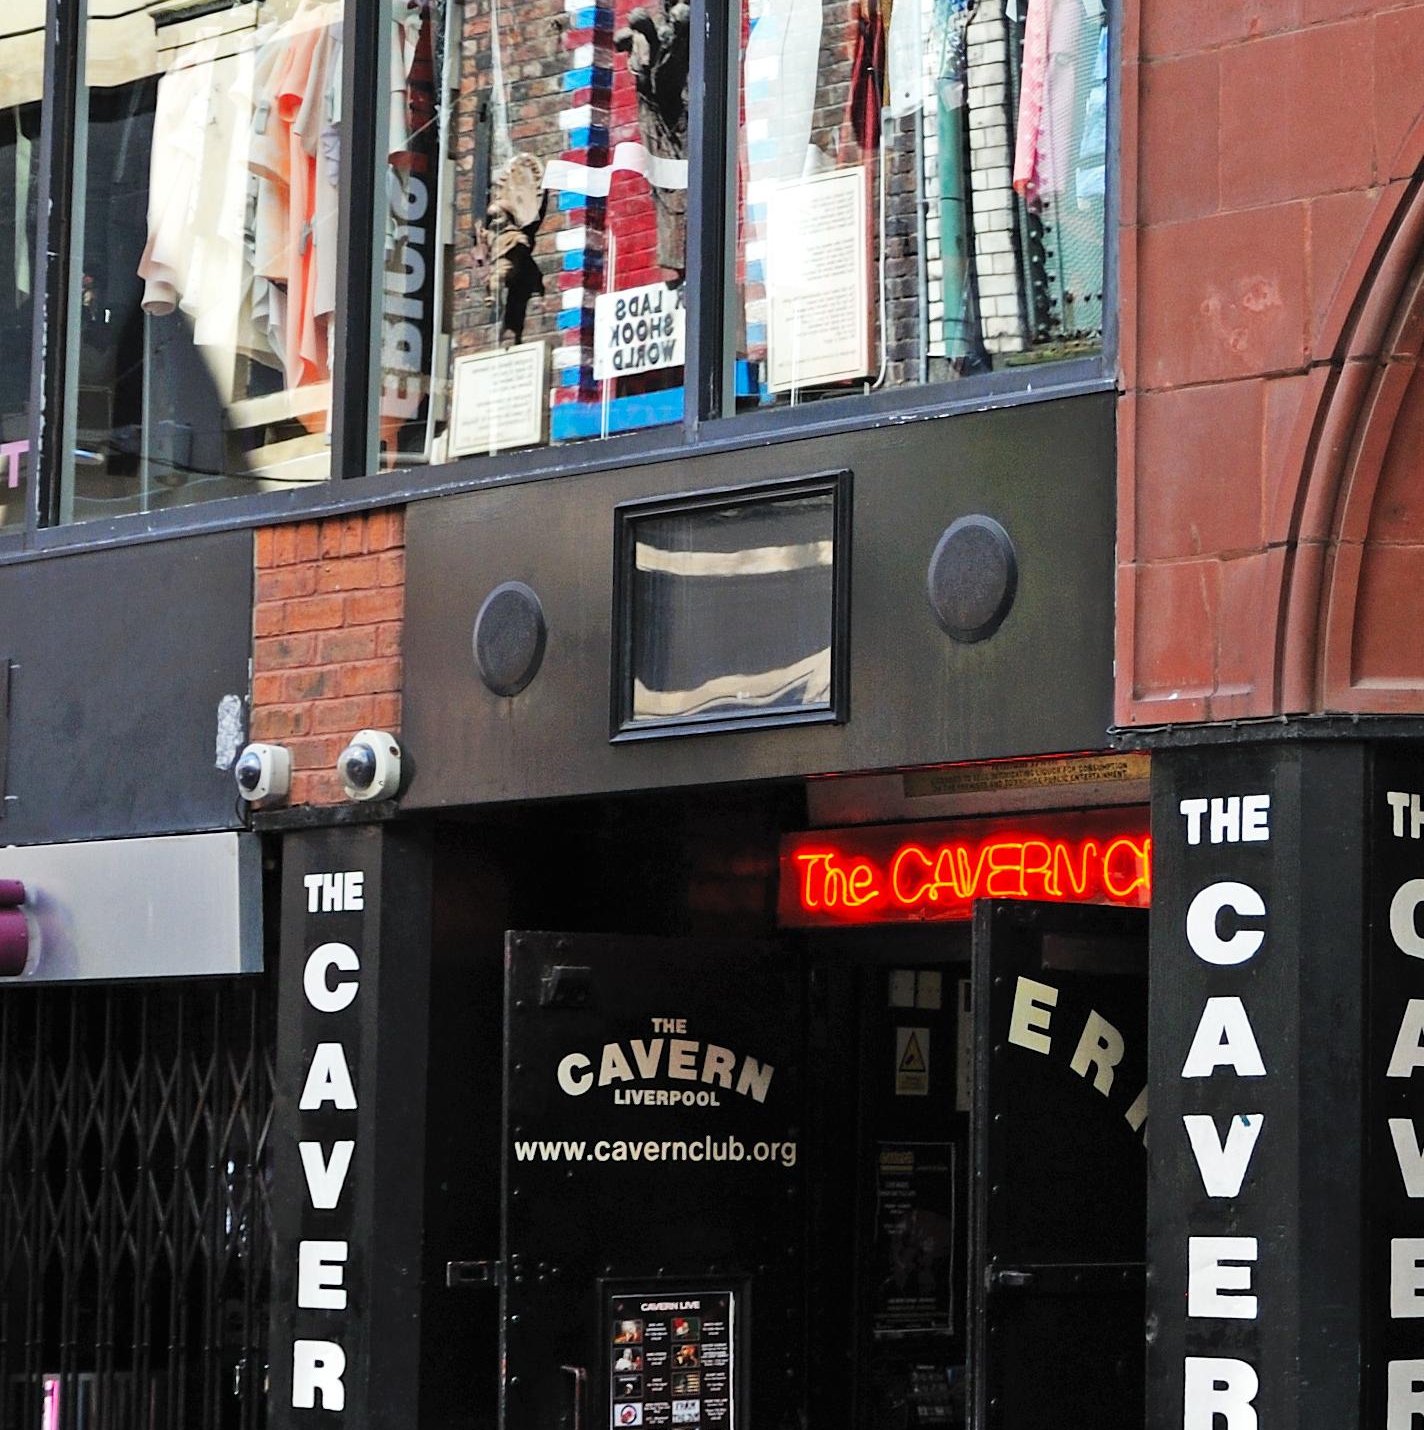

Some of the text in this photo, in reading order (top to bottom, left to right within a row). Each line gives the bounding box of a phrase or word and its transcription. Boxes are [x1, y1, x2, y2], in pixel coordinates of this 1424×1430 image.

[1180, 794, 1271, 845] THE
[303, 870, 364, 913] THE
[797, 853, 879, 906] The
[892, 841, 1098, 904] CAVERN
[651, 1017, 688, 1034] THE
[557, 1038, 775, 1104] CAVERN
[614, 1088, 721, 1107] LIVERPOOL
[514, 1135, 798, 1168] www.cavernclub.org
[640, 1300, 701, 1312] CAVERN LIVE
